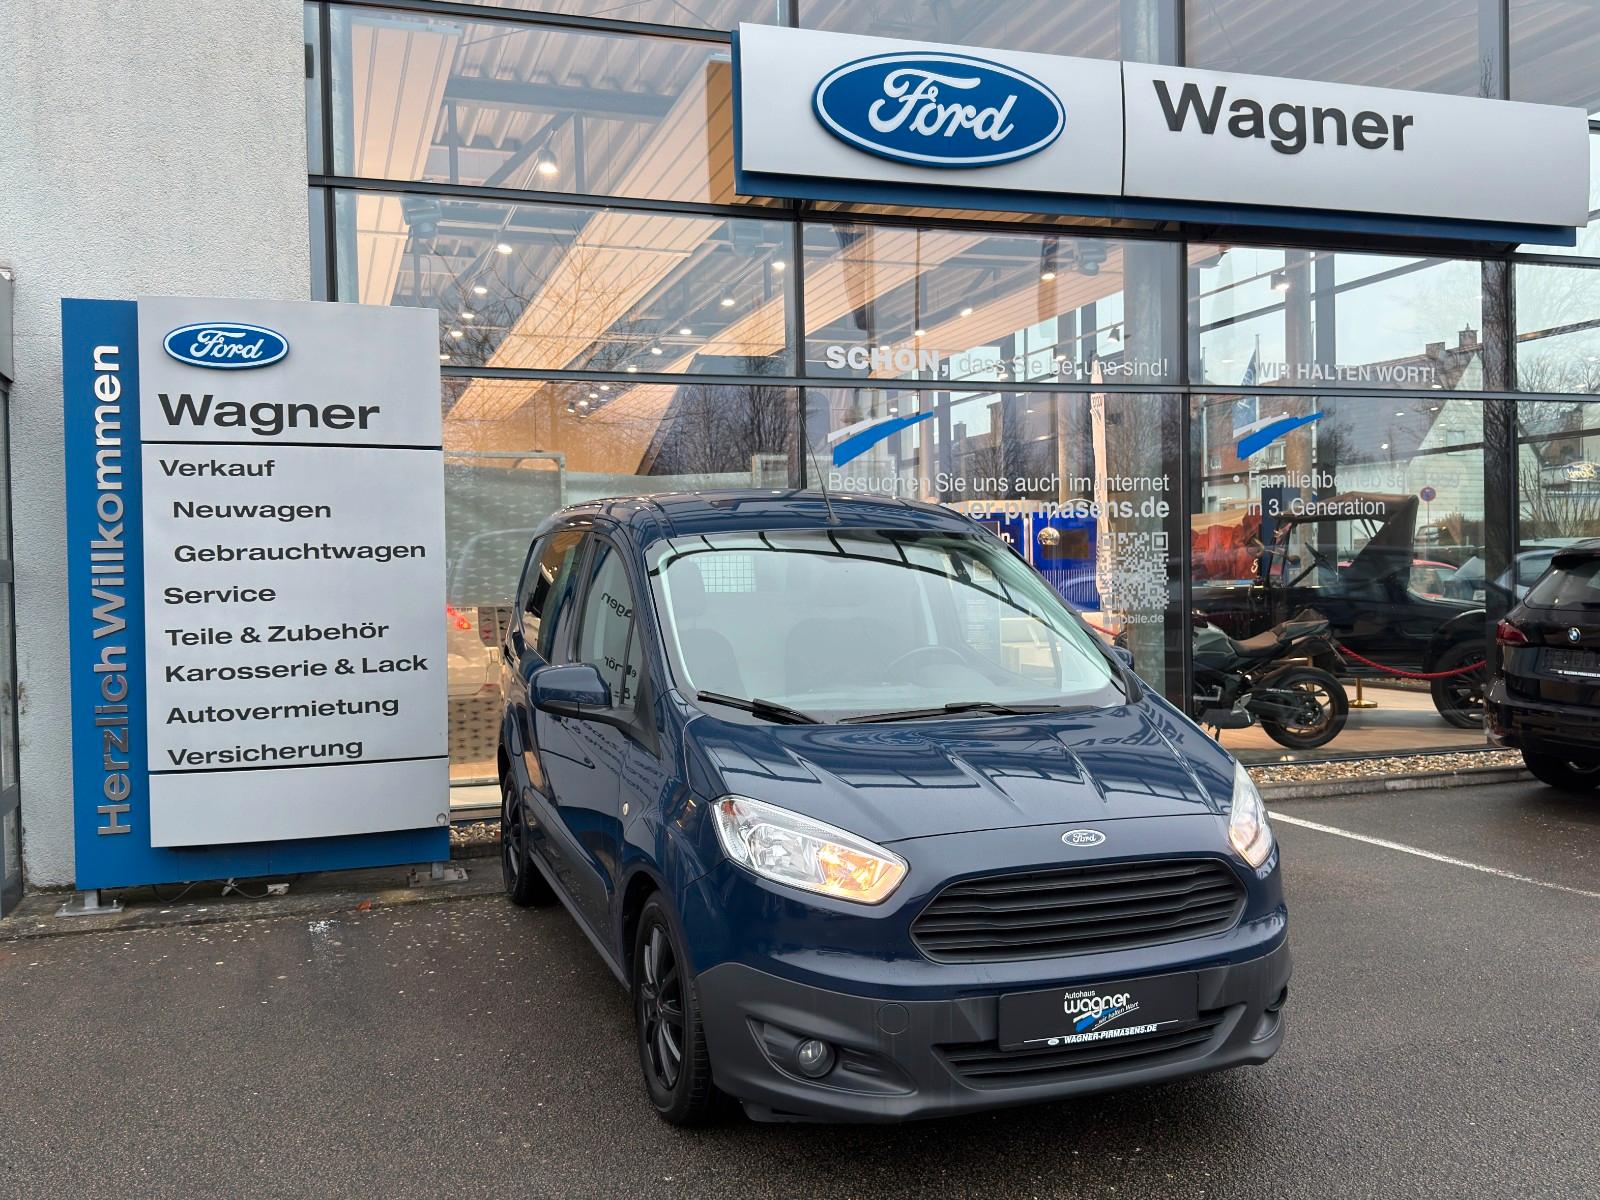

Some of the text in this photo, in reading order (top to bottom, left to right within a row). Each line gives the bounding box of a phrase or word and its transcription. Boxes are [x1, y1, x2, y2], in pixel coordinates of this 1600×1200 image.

[868, 68, 1017, 142] Ford
[1153, 80, 1414, 155] Wagner
[189, 329, 264, 360] Ford
[959, 354, 1006, 374] dass
[1012, 356, 1043, 375] Sie
[1050, 355, 1078, 375] bei
[1084, 360, 1118, 376] uns
[1123, 357, 1169, 377] sind!
[1258, 361, 1436, 382] WIR HALTEN WORT!
[158, 394, 380, 435] Wagner
[160, 459, 276, 477] Verkauf
[828, 472, 931, 492] Besuchen
[935, 472, 966, 492] Sie
[973, 477, 1007, 492] uns
[1016, 472, 1061, 492] auch
[1069, 473, 1092, 491] im
[173, 501, 331, 522] Neuwagen
[1247, 498, 1385, 516] in 3. Generation
[174, 543, 426, 563] Gebrauchtwagen
[91, 345, 131, 835] Herzlich Willkommen
[164, 586, 277, 605] Service
[165, 622, 390, 646] Teile & Zubehör
[166, 654, 429, 682] Karosserie & Lack
[167, 699, 399, 725] Autovermietung
[168, 740, 364, 766] Versicherung
[1064, 990, 1096, 1000] Autohaus
[1064, 1024, 1158, 1044] WAGNER-PIRMASENS.DE
